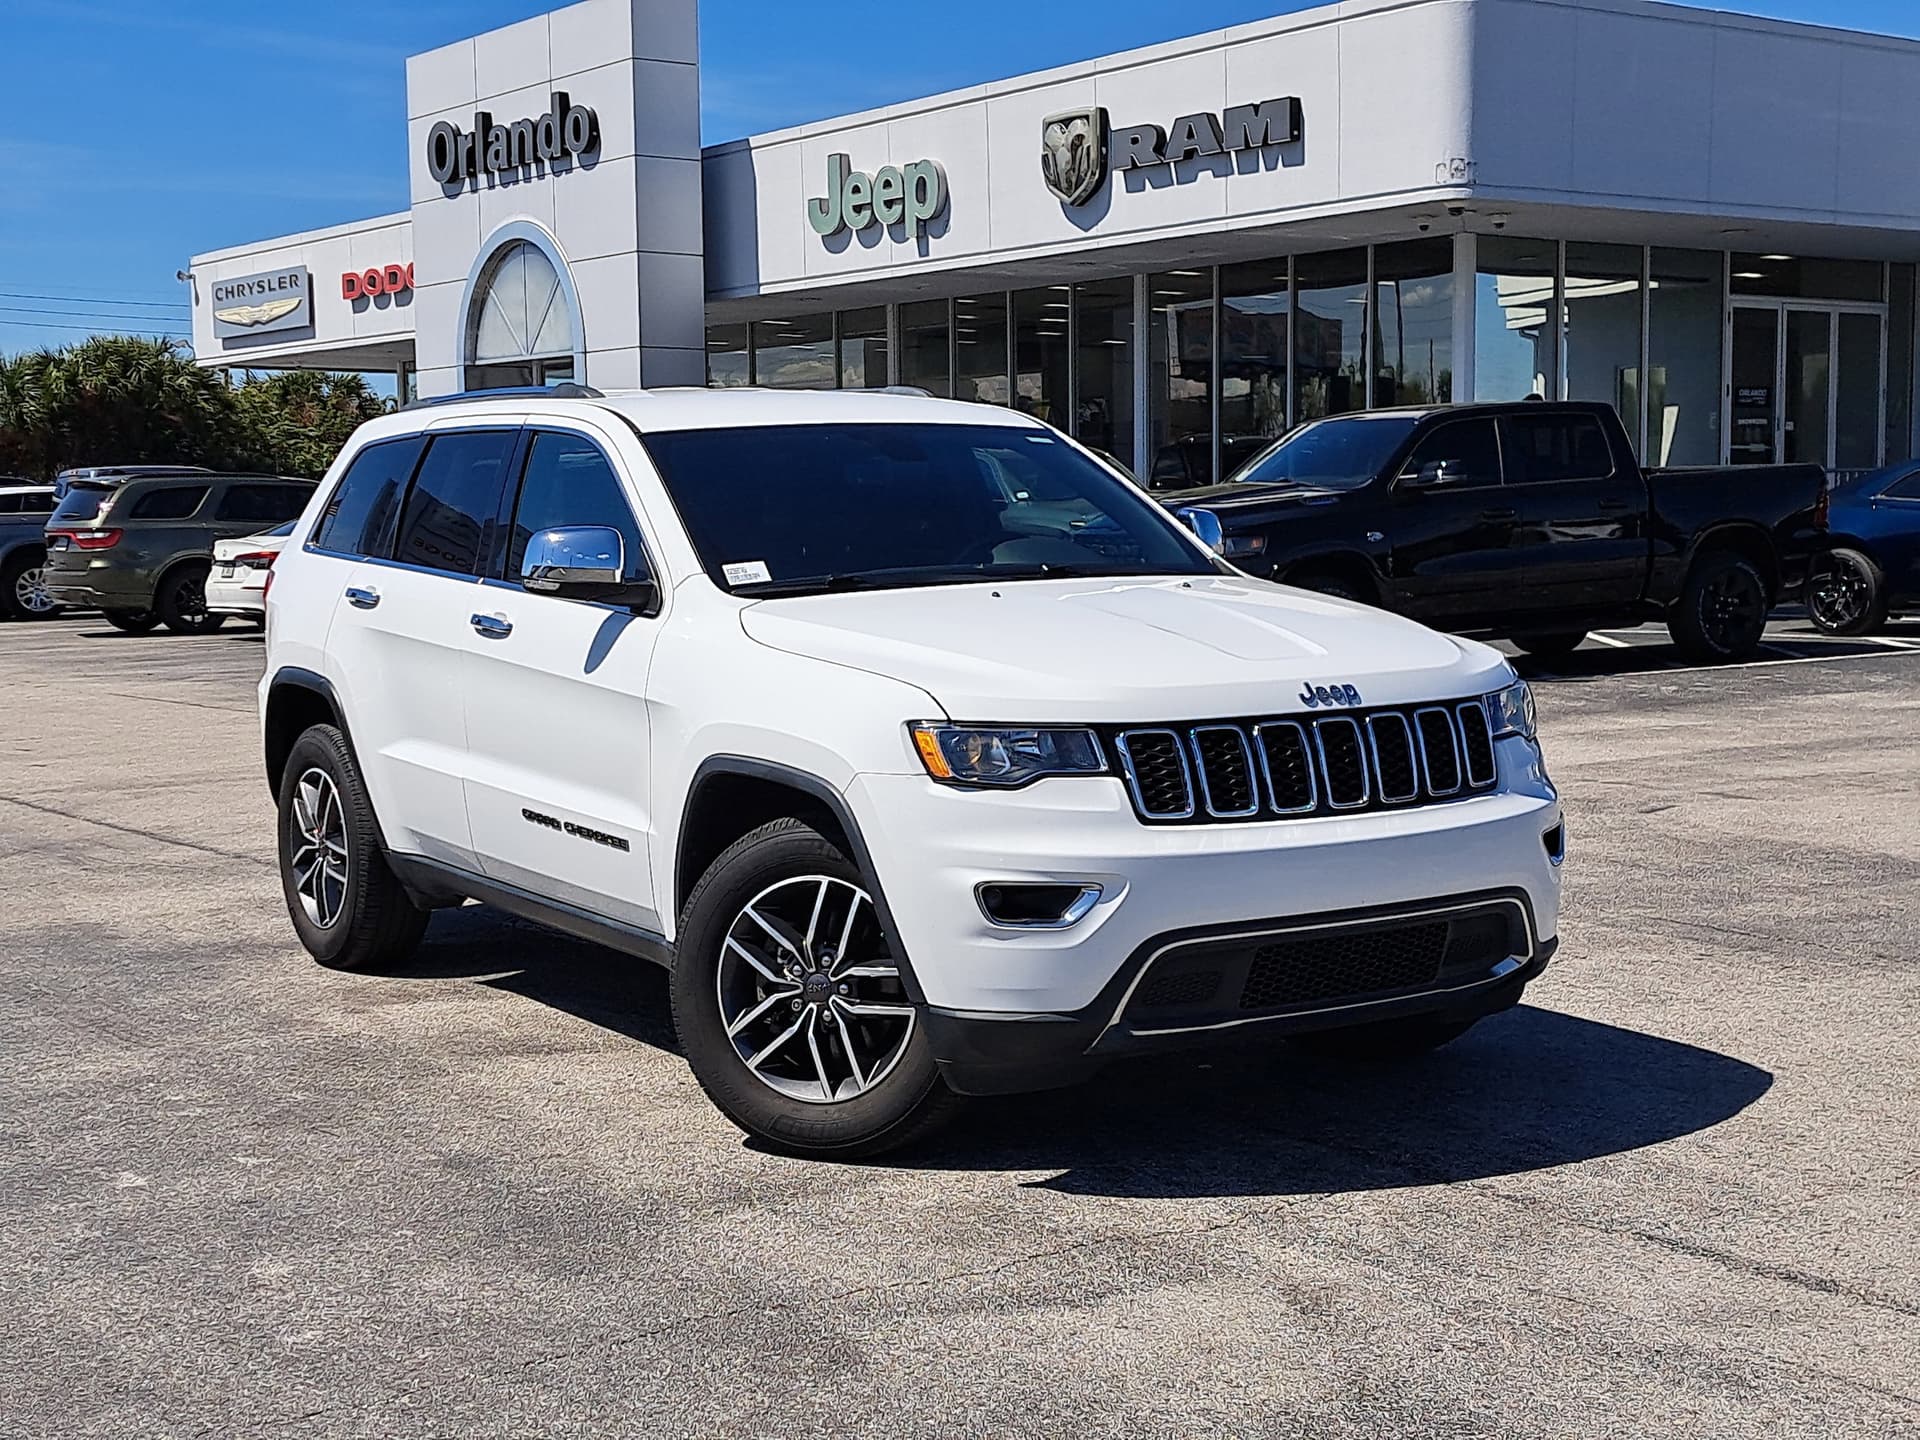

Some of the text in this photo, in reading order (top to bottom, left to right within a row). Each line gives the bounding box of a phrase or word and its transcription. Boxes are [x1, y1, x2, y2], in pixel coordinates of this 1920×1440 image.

[427, 91, 600, 183] Orlando
[1112, 97, 1301, 171] RAM
[808, 153, 948, 239] Jeep
[215, 273, 300, 301] CHRYSLER
[1299, 682, 1362, 708] Jeep
